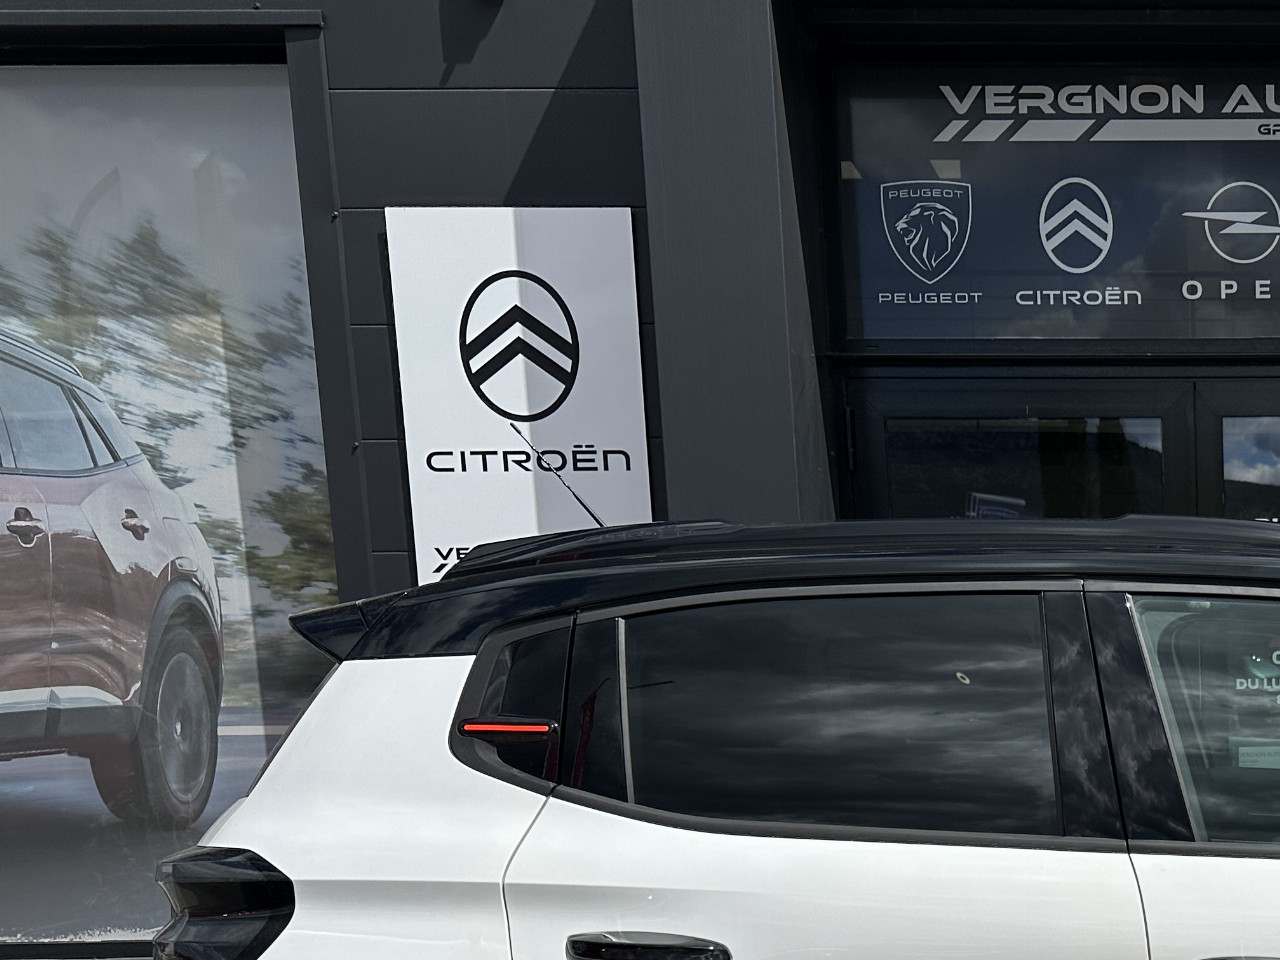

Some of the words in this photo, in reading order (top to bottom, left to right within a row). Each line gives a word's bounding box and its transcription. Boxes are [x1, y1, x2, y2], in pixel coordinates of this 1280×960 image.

[940, 85, 1204, 114] VERGNON
[889, 189, 962, 198] PEUGEOT
[879, 293, 982, 303] PEUGEOT
[1236, 678, 1259, 690] DU
